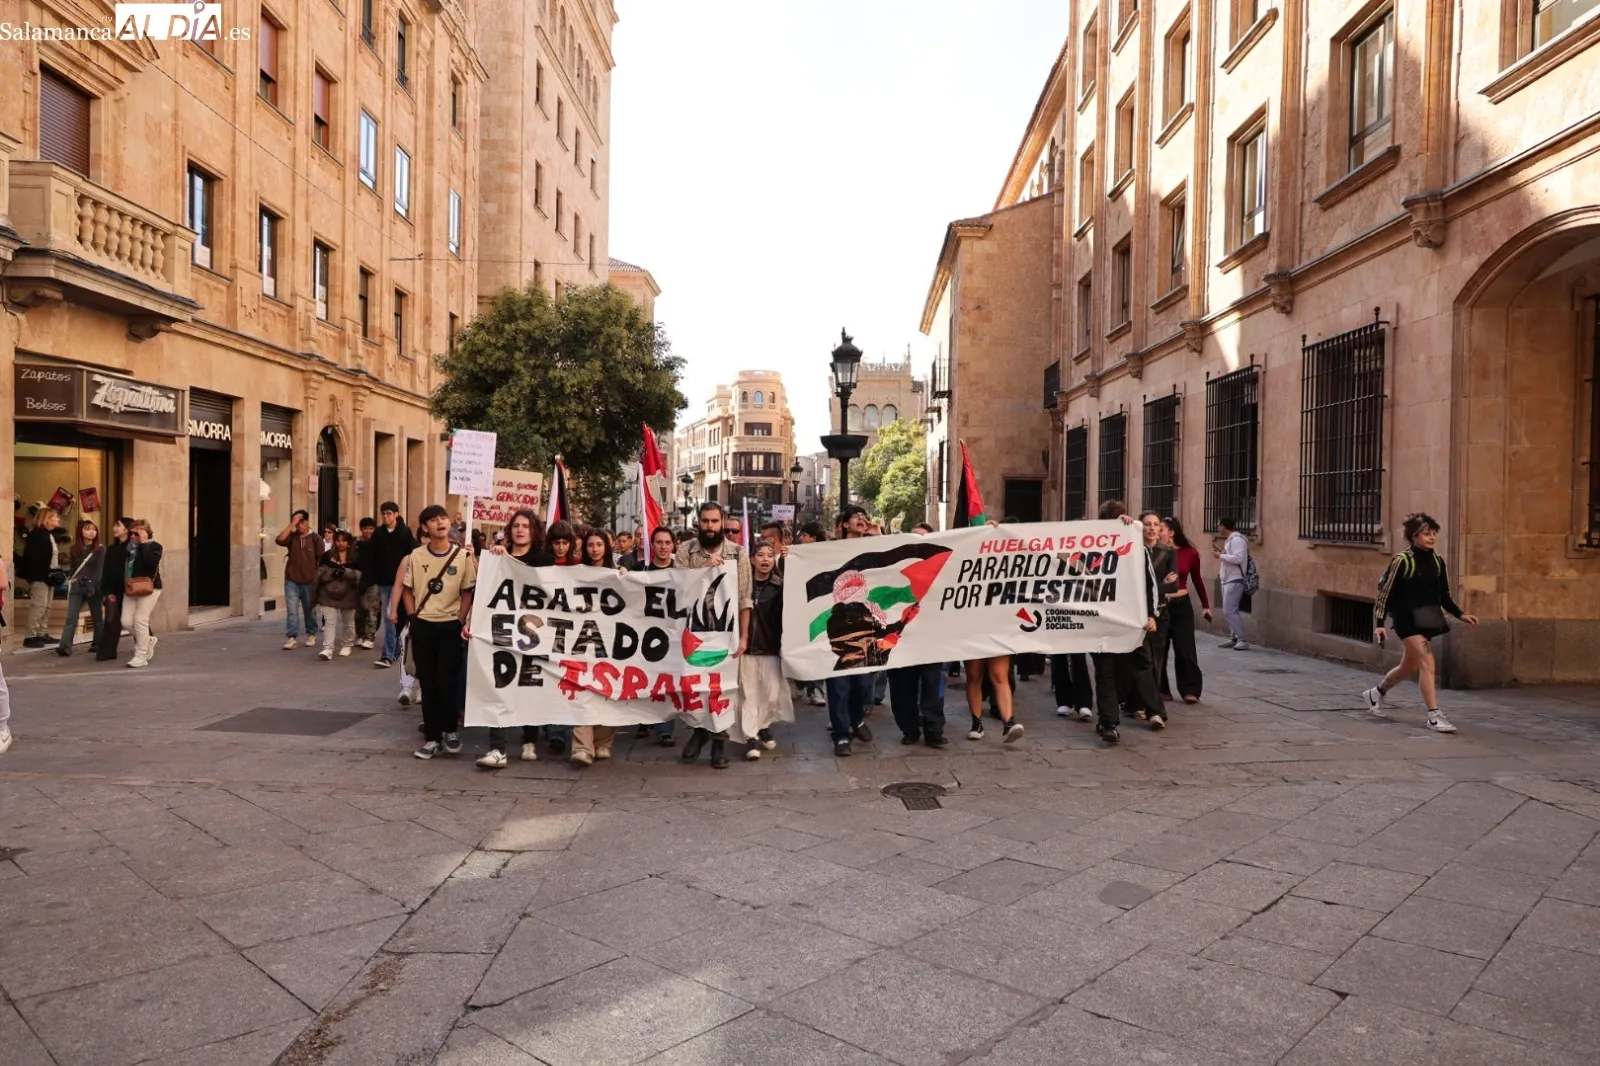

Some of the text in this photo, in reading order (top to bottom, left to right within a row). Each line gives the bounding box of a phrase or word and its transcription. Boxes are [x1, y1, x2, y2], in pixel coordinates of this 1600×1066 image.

[21, 368, 71, 383] Zapatos
[25, 396, 67, 411] Bolsos
[259, 430, 293, 449] IMORRA
[979, 534, 1121, 554] HUELGA 15 OCT
[957, 550, 1119, 583] PARARLO TODO
[487, 578, 689, 619] ABAJO EL
[940, 578, 1117, 611] POR PALESTINA
[1045, 608, 1100, 617] COORDINADORA
[1045, 622, 1085, 630] SOCIALISTA
[491, 613, 670, 663] ESTADO
[492, 650, 731, 717] DE ISRAEL
